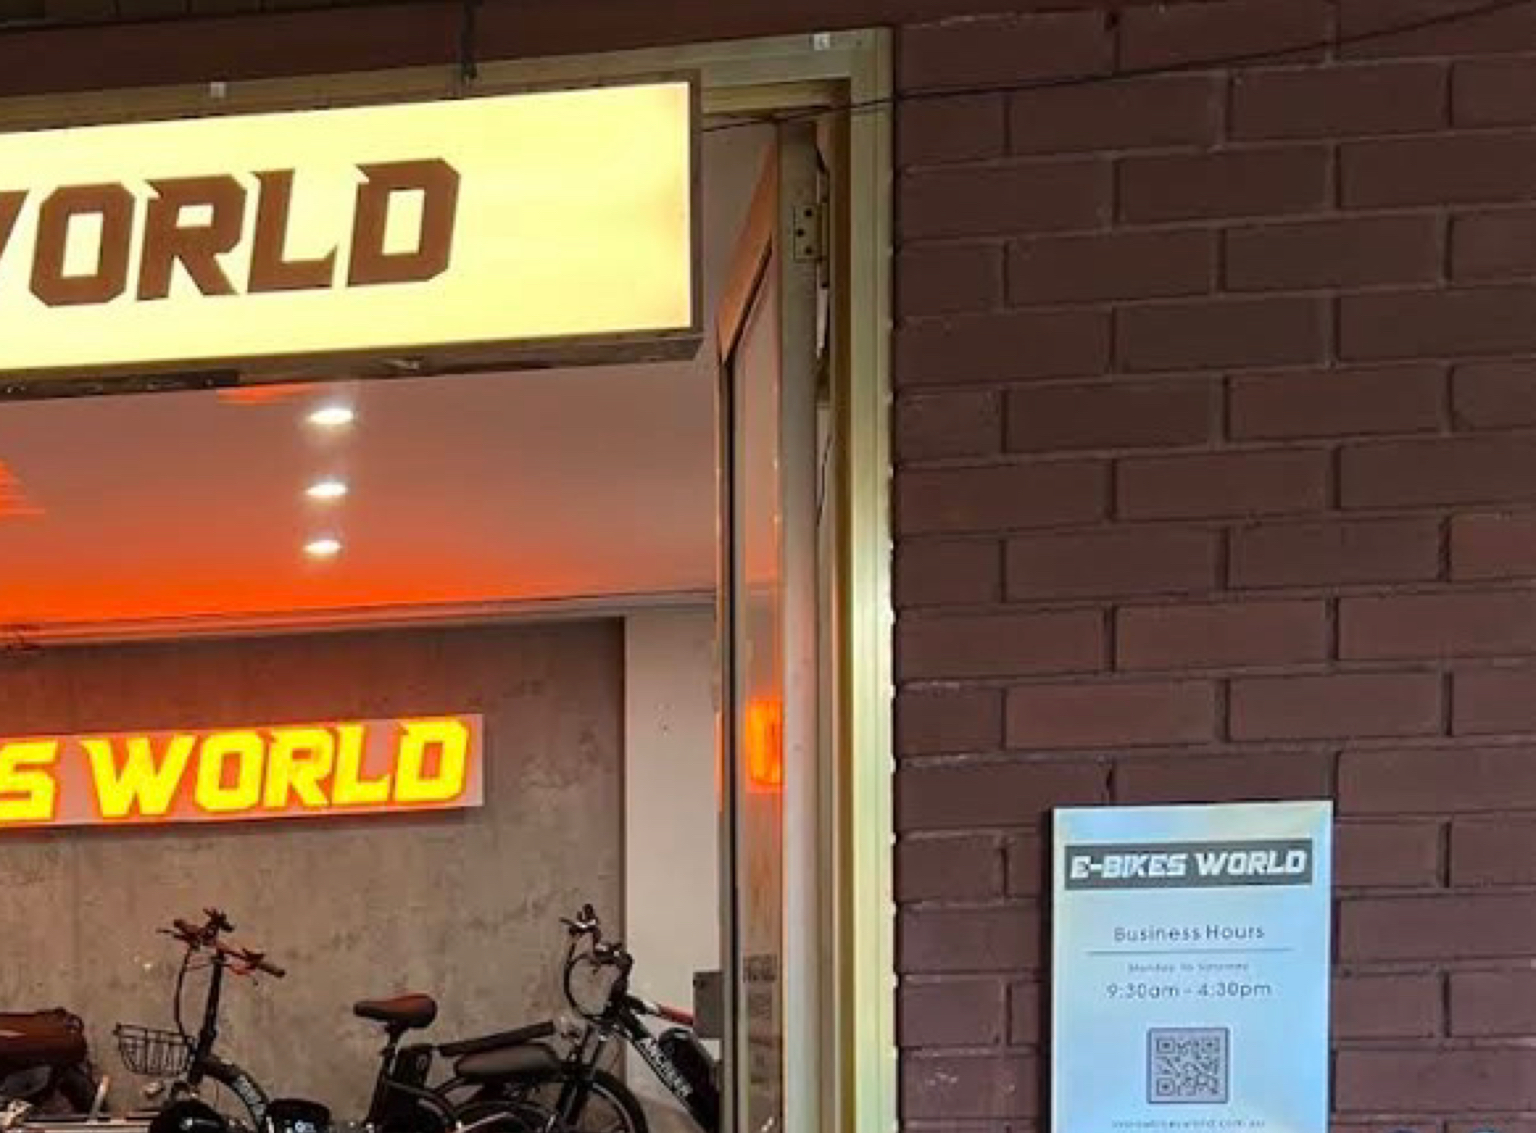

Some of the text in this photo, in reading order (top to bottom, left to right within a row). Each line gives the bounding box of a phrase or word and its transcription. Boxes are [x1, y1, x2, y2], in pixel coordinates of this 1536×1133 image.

[77, 716, 468, 818] WORLD
[1070, 849, 1307, 879] E-BIKES WORLD
[1113, 924, 1265, 942] Business Hours
[1106, 983, 1180, 999] 9:30am
